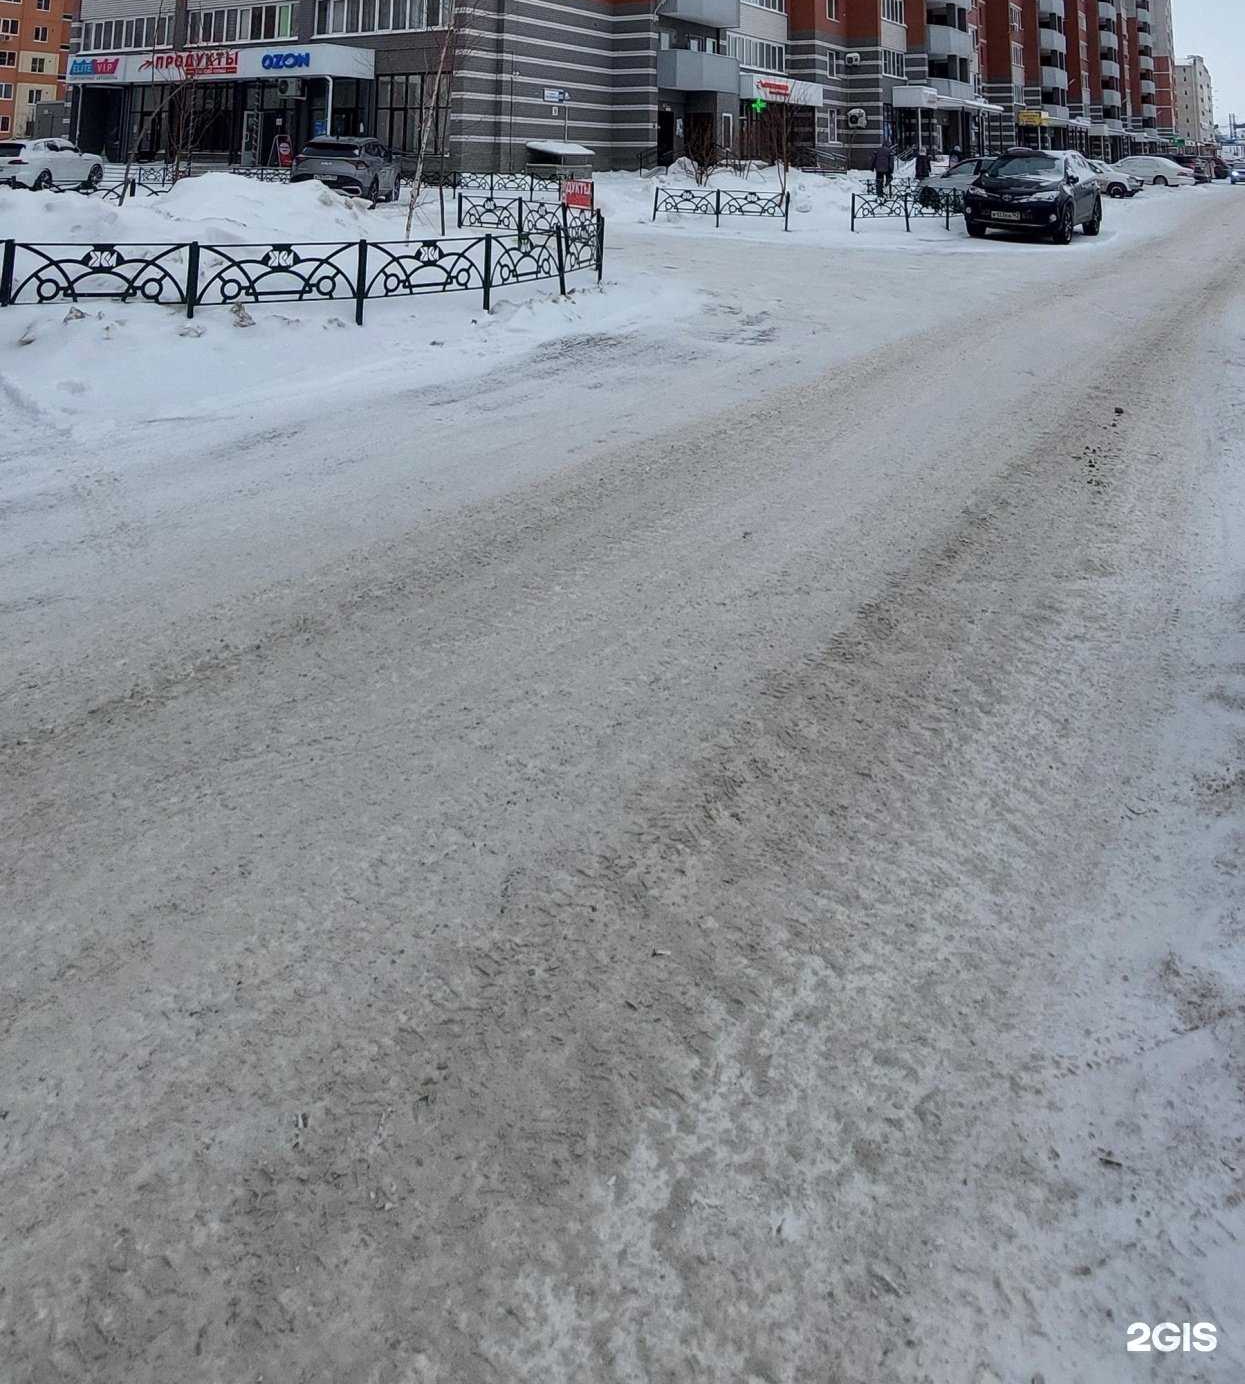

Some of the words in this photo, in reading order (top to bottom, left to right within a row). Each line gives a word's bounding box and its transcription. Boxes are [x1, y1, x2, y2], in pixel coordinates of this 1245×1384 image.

[72, 63, 93, 73] ELITE
[155, 51, 240, 70] ПРОДУКТЫ
[261, 52, 310, 70] OZON
